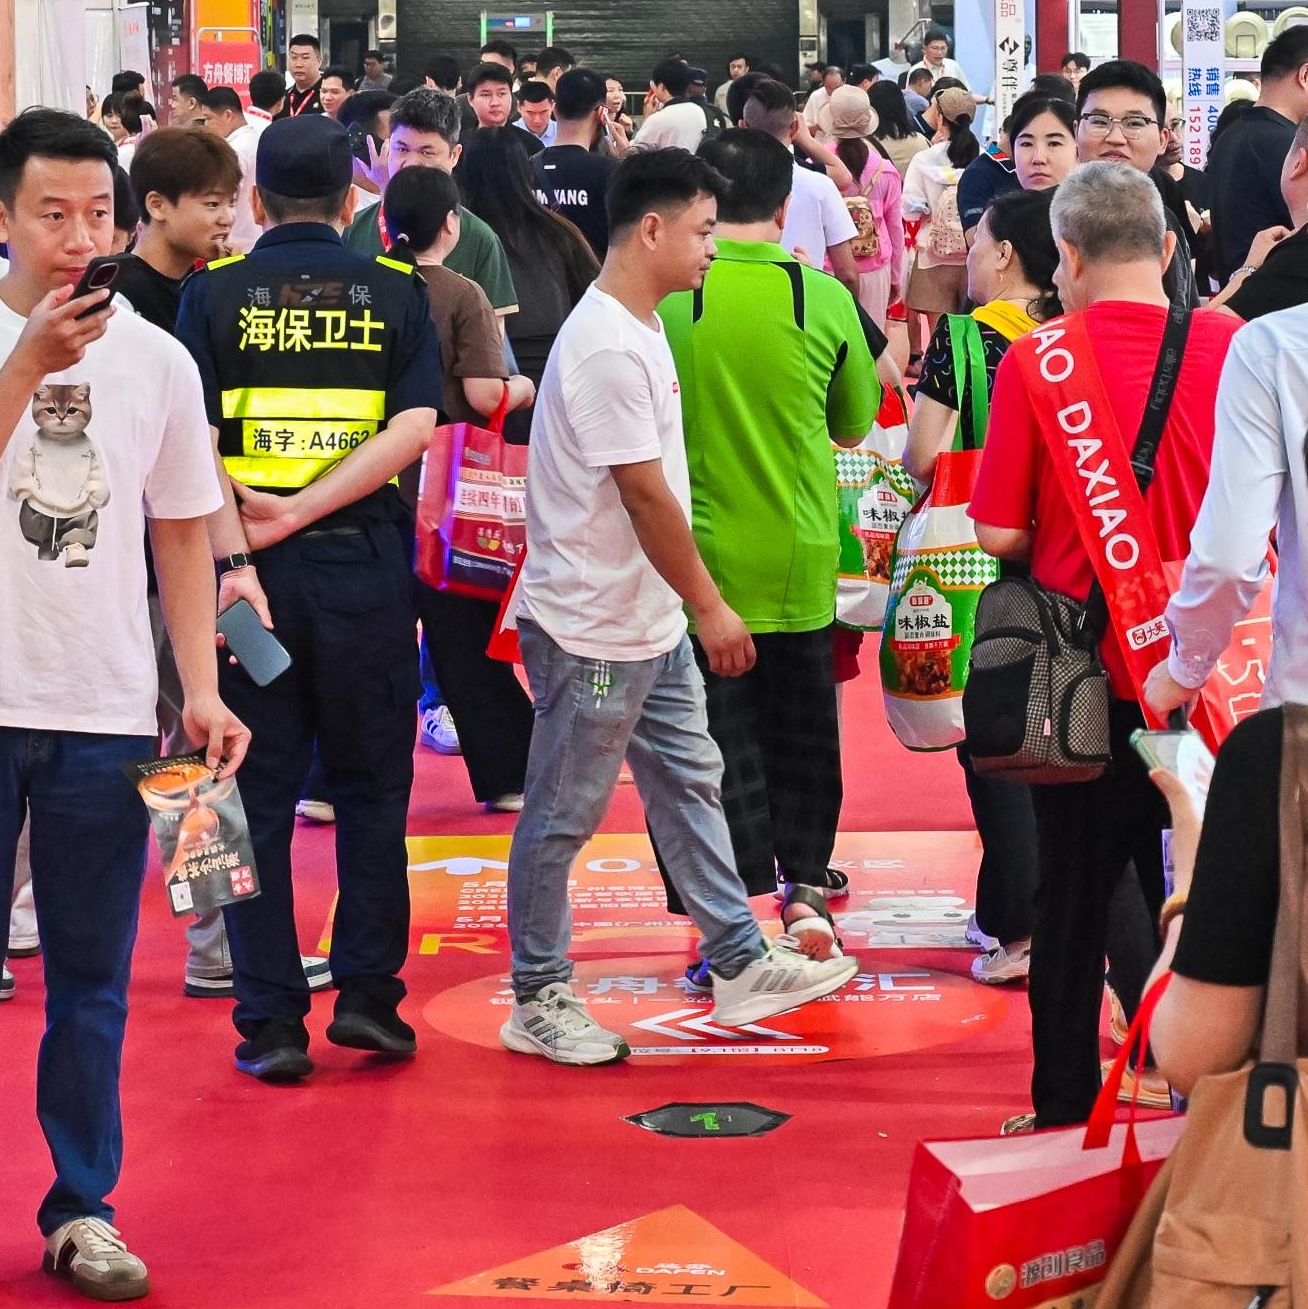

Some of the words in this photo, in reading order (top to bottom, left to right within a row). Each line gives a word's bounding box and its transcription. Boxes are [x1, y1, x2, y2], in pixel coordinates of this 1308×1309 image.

[202, 62, 253, 85] 方舟餐博汇
[1205, 67, 1220, 96] 销售
[1189, 106, 1201, 133] 152
[238, 306, 385, 352] 海保卫士
[1057, 400, 1140, 571] DAXIAO
[898, 613, 951, 631] 味椒盐
[635, 1266, 727, 1277] DAFEN
